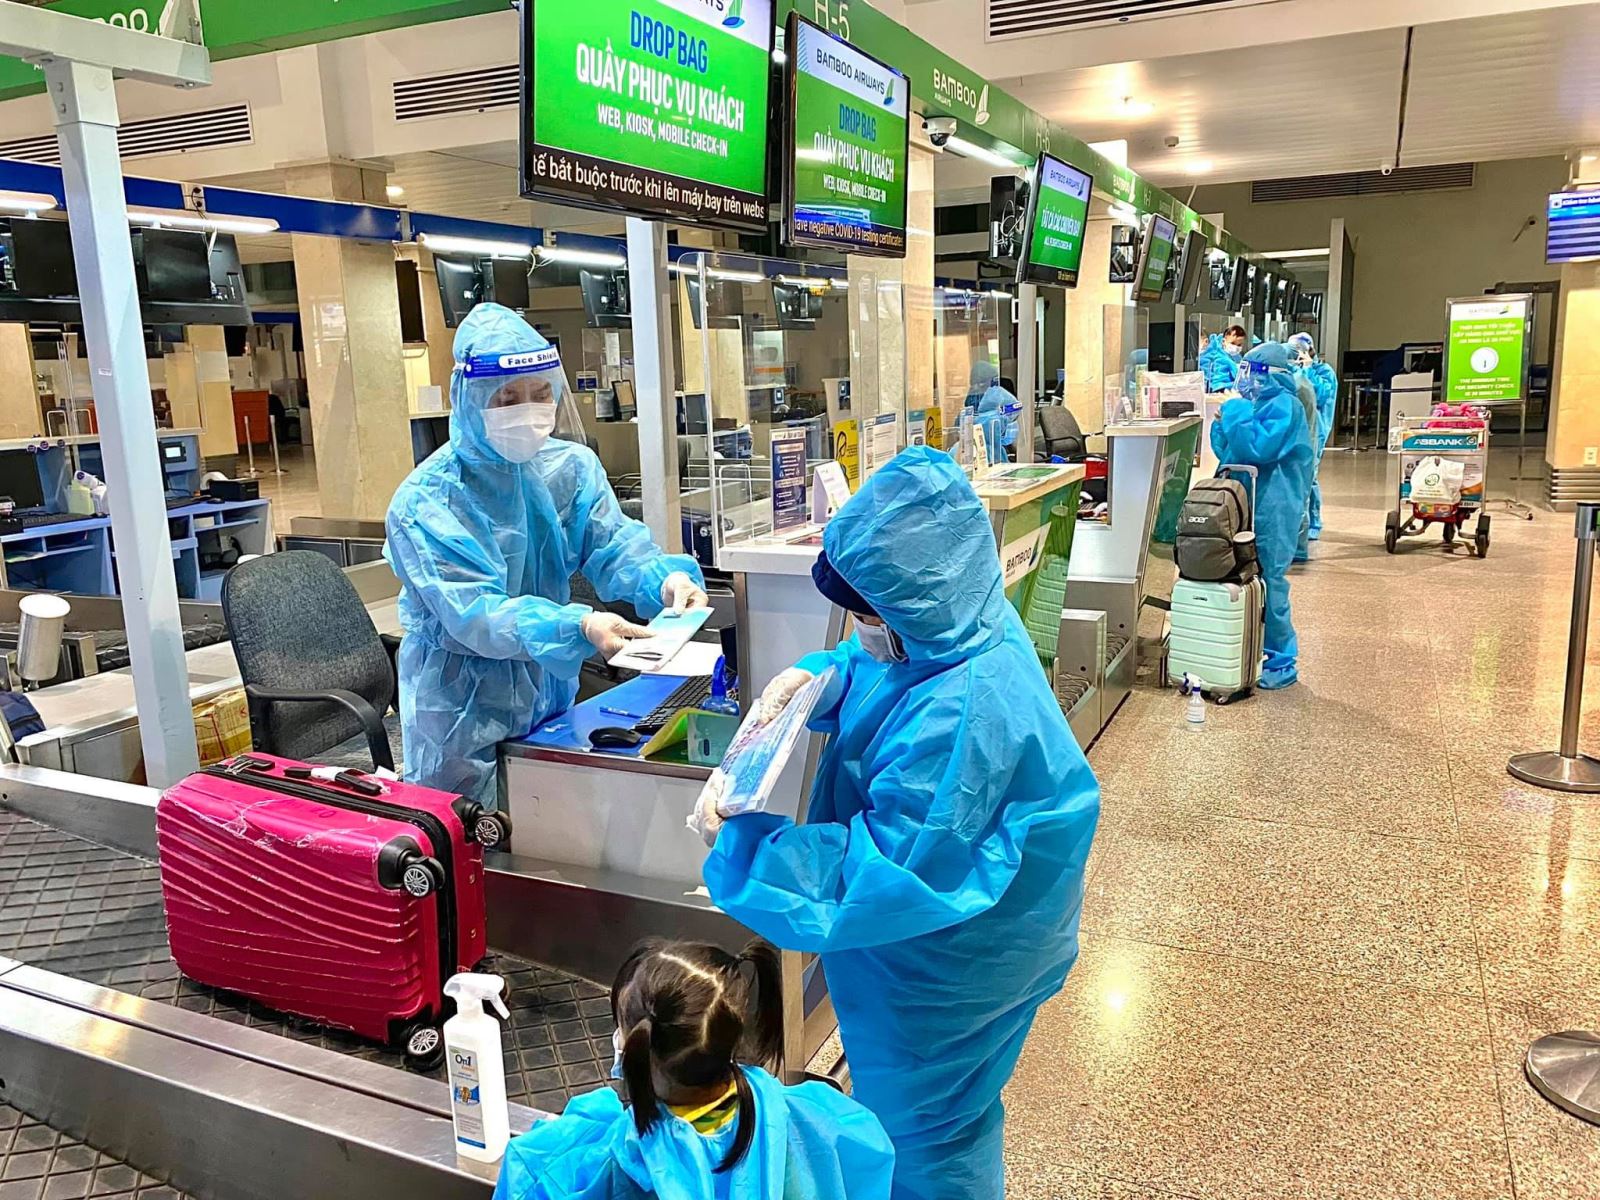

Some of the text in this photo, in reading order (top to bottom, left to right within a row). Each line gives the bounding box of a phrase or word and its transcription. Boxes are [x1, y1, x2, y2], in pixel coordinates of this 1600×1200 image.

[814, 0, 850, 41] H-5
[631, 10, 708, 73] DROP BAG
[576, 37, 744, 132] QUẦY PHỤC VỤ KHÁCH
[816, 48, 885, 95] BAMBOO AIRWAYS
[933, 68, 977, 109] BAMBOO
[598, 103, 728, 158] WEB, KIOSK, MOBILE CHECK-IN
[839, 103, 877, 142] DROP BAG
[838, 140, 860, 177] PHỤC
[860, 148, 871, 182] VỤ
[872, 149, 894, 182] KHÁCH
[550, 156, 572, 182] bắt
[575, 163, 608, 191] buộc
[610, 171, 642, 195] trước
[644, 176, 661, 200] khi
[663, 181, 679, 203] lên
[682, 187, 702, 211] máy
[704, 190, 721, 215] bay
[723, 196, 741, 215] trên
[743, 201, 764, 219] webs
[852, 181, 867, 198] MOBILE
[808, 220, 834, 238] negative
[834, 223, 861, 239] COVID-19
[862, 229, 878, 246] testing
[508, 356, 534, 366] Face
[1188, 516, 1208, 524] acer
